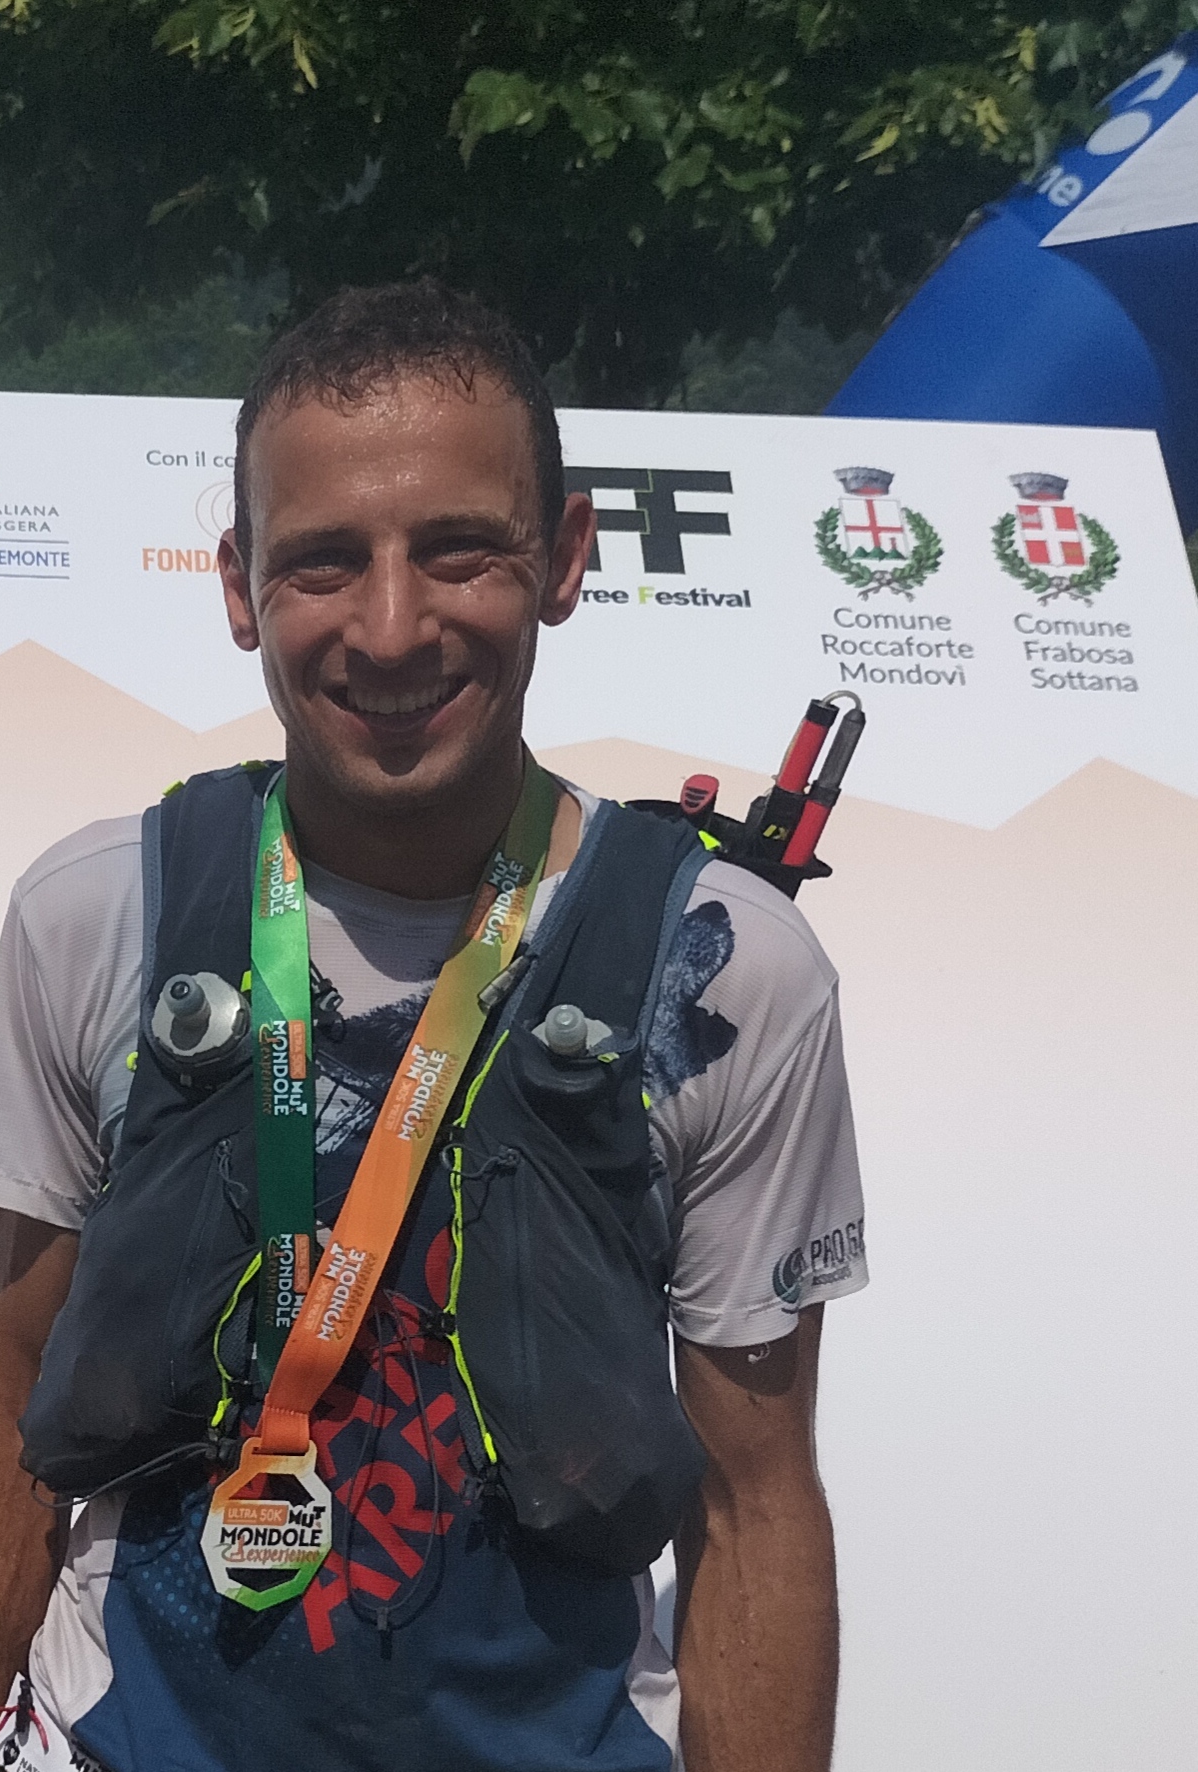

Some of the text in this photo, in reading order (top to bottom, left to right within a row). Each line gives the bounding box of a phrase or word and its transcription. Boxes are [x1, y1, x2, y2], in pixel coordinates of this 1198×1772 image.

[146, 450, 188, 467] Con
[195, 451, 206, 467] il
[580, 585, 752, 608] ree Festival
[833, 607, 952, 631] Comune
[1013, 613, 1132, 638] Comune
[820, 633, 975, 660] Roccaforte
[1023, 640, 1134, 666] Frabosa
[839, 661, 967, 687] Mondovì
[1030, 667, 1139, 693] Sottana
[270, 838, 284, 918] MONDOLE
[488, 852, 508, 885] MUT
[283, 881, 301, 912] MUT
[480, 860, 523, 946] MONDOLE
[272, 1020, 289, 1116] MONDOLE
[405, 1044, 429, 1079] MUT
[289, 1081, 307, 1116] MUT
[397, 1050, 447, 1141] MONDOLE
[324, 1242, 348, 1279] MUT
[276, 1233, 294, 1328] MONDOLE
[317, 1248, 366, 1341] MONDOLE
[291, 1295, 306, 1319] MU
[227, 1506, 326, 1528] ULTRA 50K MUT
[220, 1526, 323, 1547] MONDOLE
